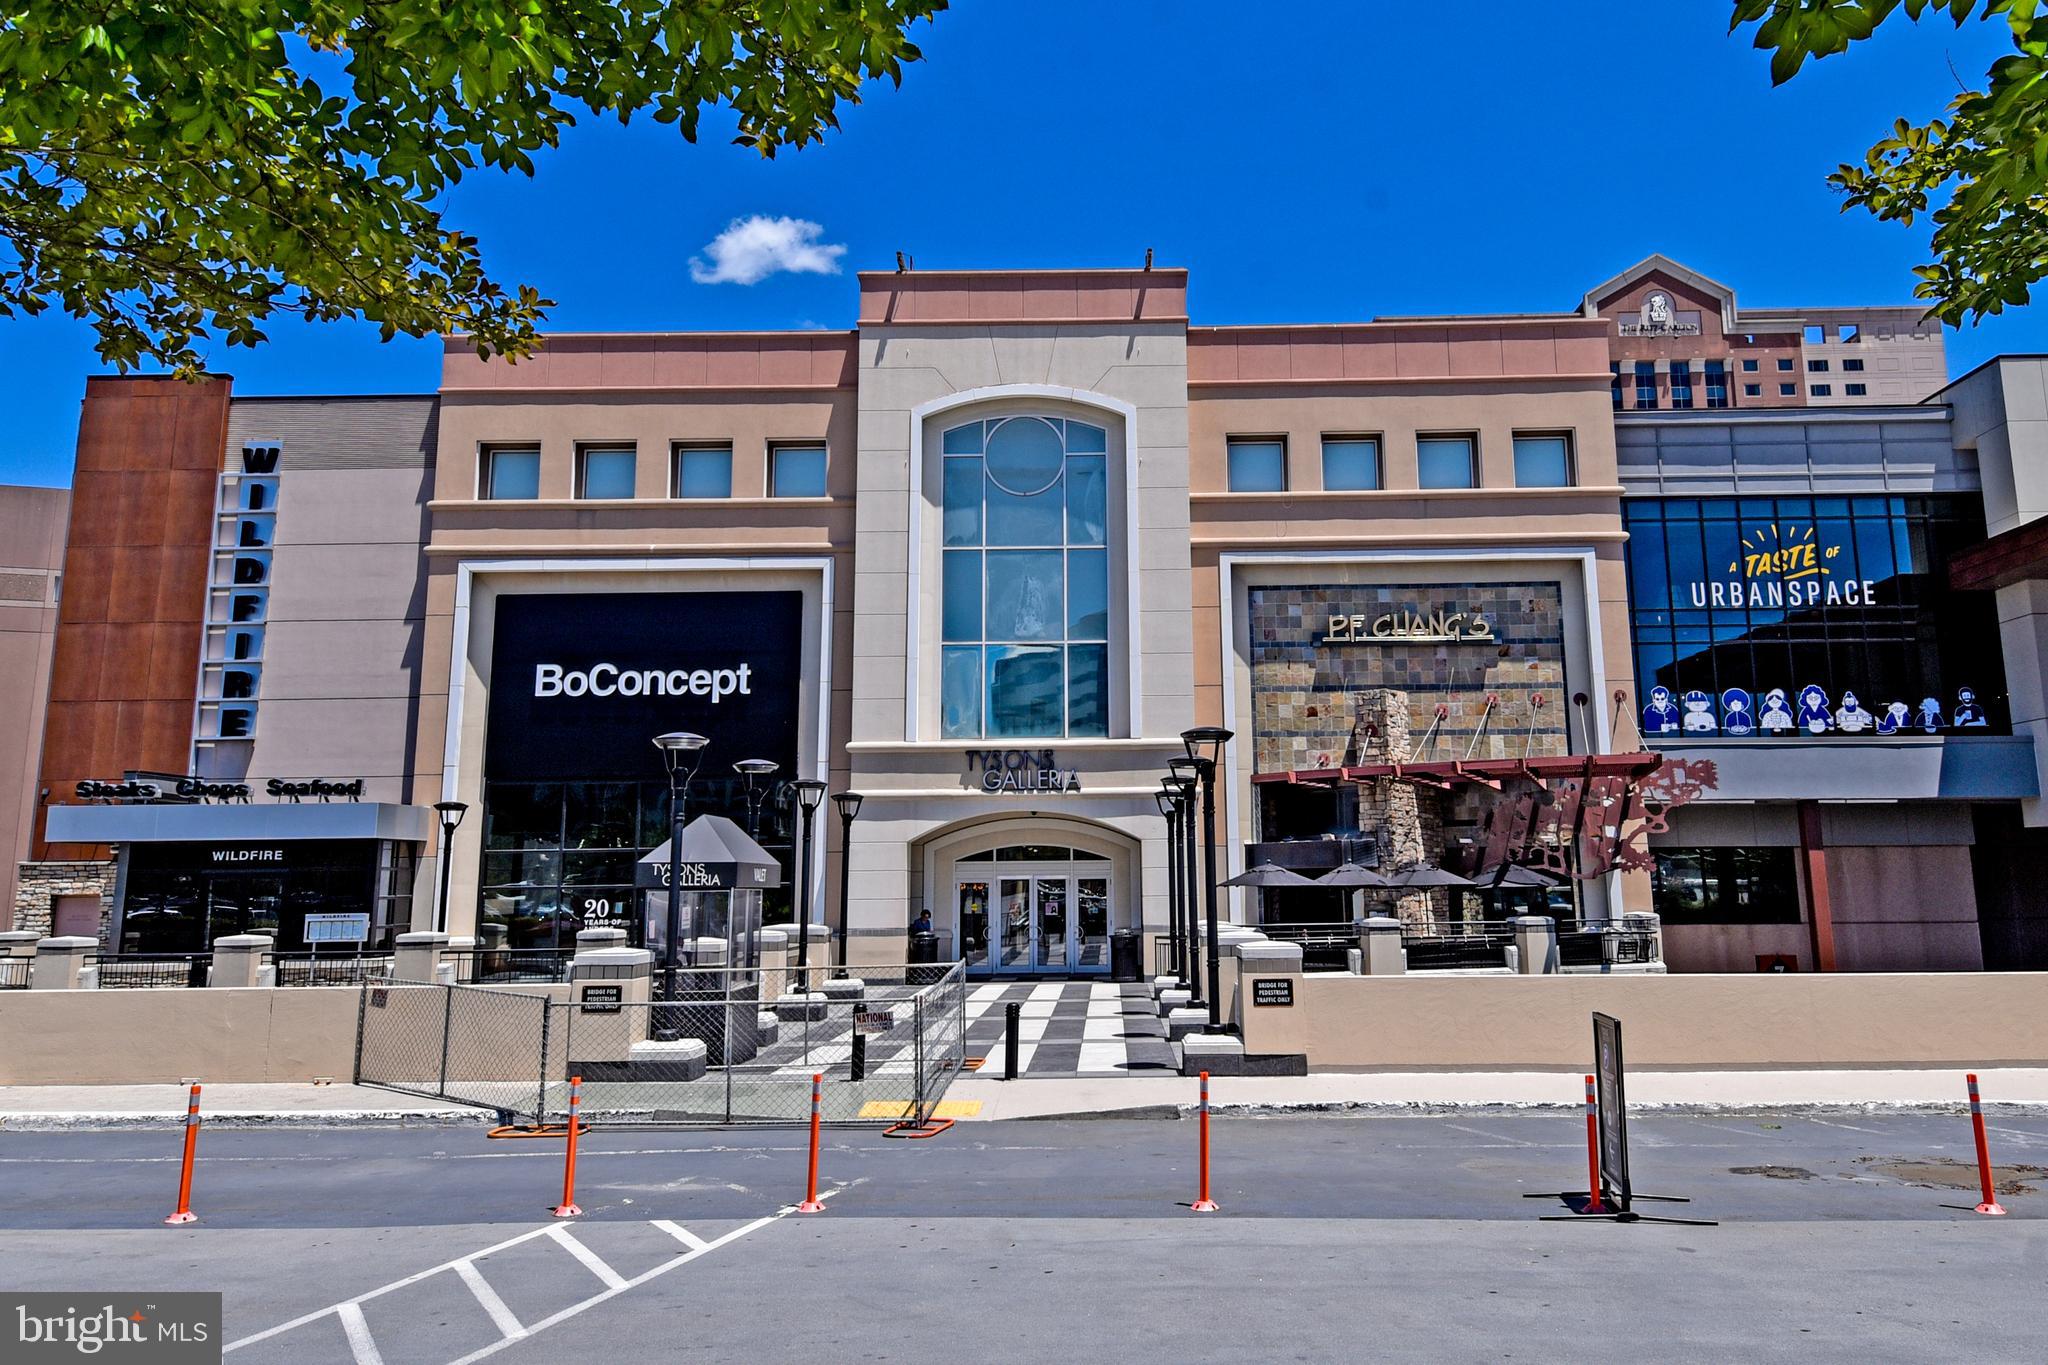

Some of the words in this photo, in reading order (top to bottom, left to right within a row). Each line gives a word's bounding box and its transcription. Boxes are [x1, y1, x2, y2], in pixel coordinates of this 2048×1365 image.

[1729, 561, 1737, 573] A
[1745, 543, 1817, 578] TASTE
[1825, 545, 1841, 559] OF
[220, 447, 281, 737] WILDFIRE
[1691, 580, 1877, 607] URBANSPACE
[534, 662, 752, 703] BoConcept
[965, 749, 1055, 772] TYSONS
[75, 780, 158, 799] Steaks
[175, 779, 248, 798] Chops
[266, 778, 364, 797] Seafood
[982, 769, 1081, 791] GALLERIA
[212, 850, 283, 861] WILDFIRE
[661, 873, 721, 887] GLLERIA
[584, 899, 609, 918] 20
[856, 1012, 893, 1023] NATIONAL
